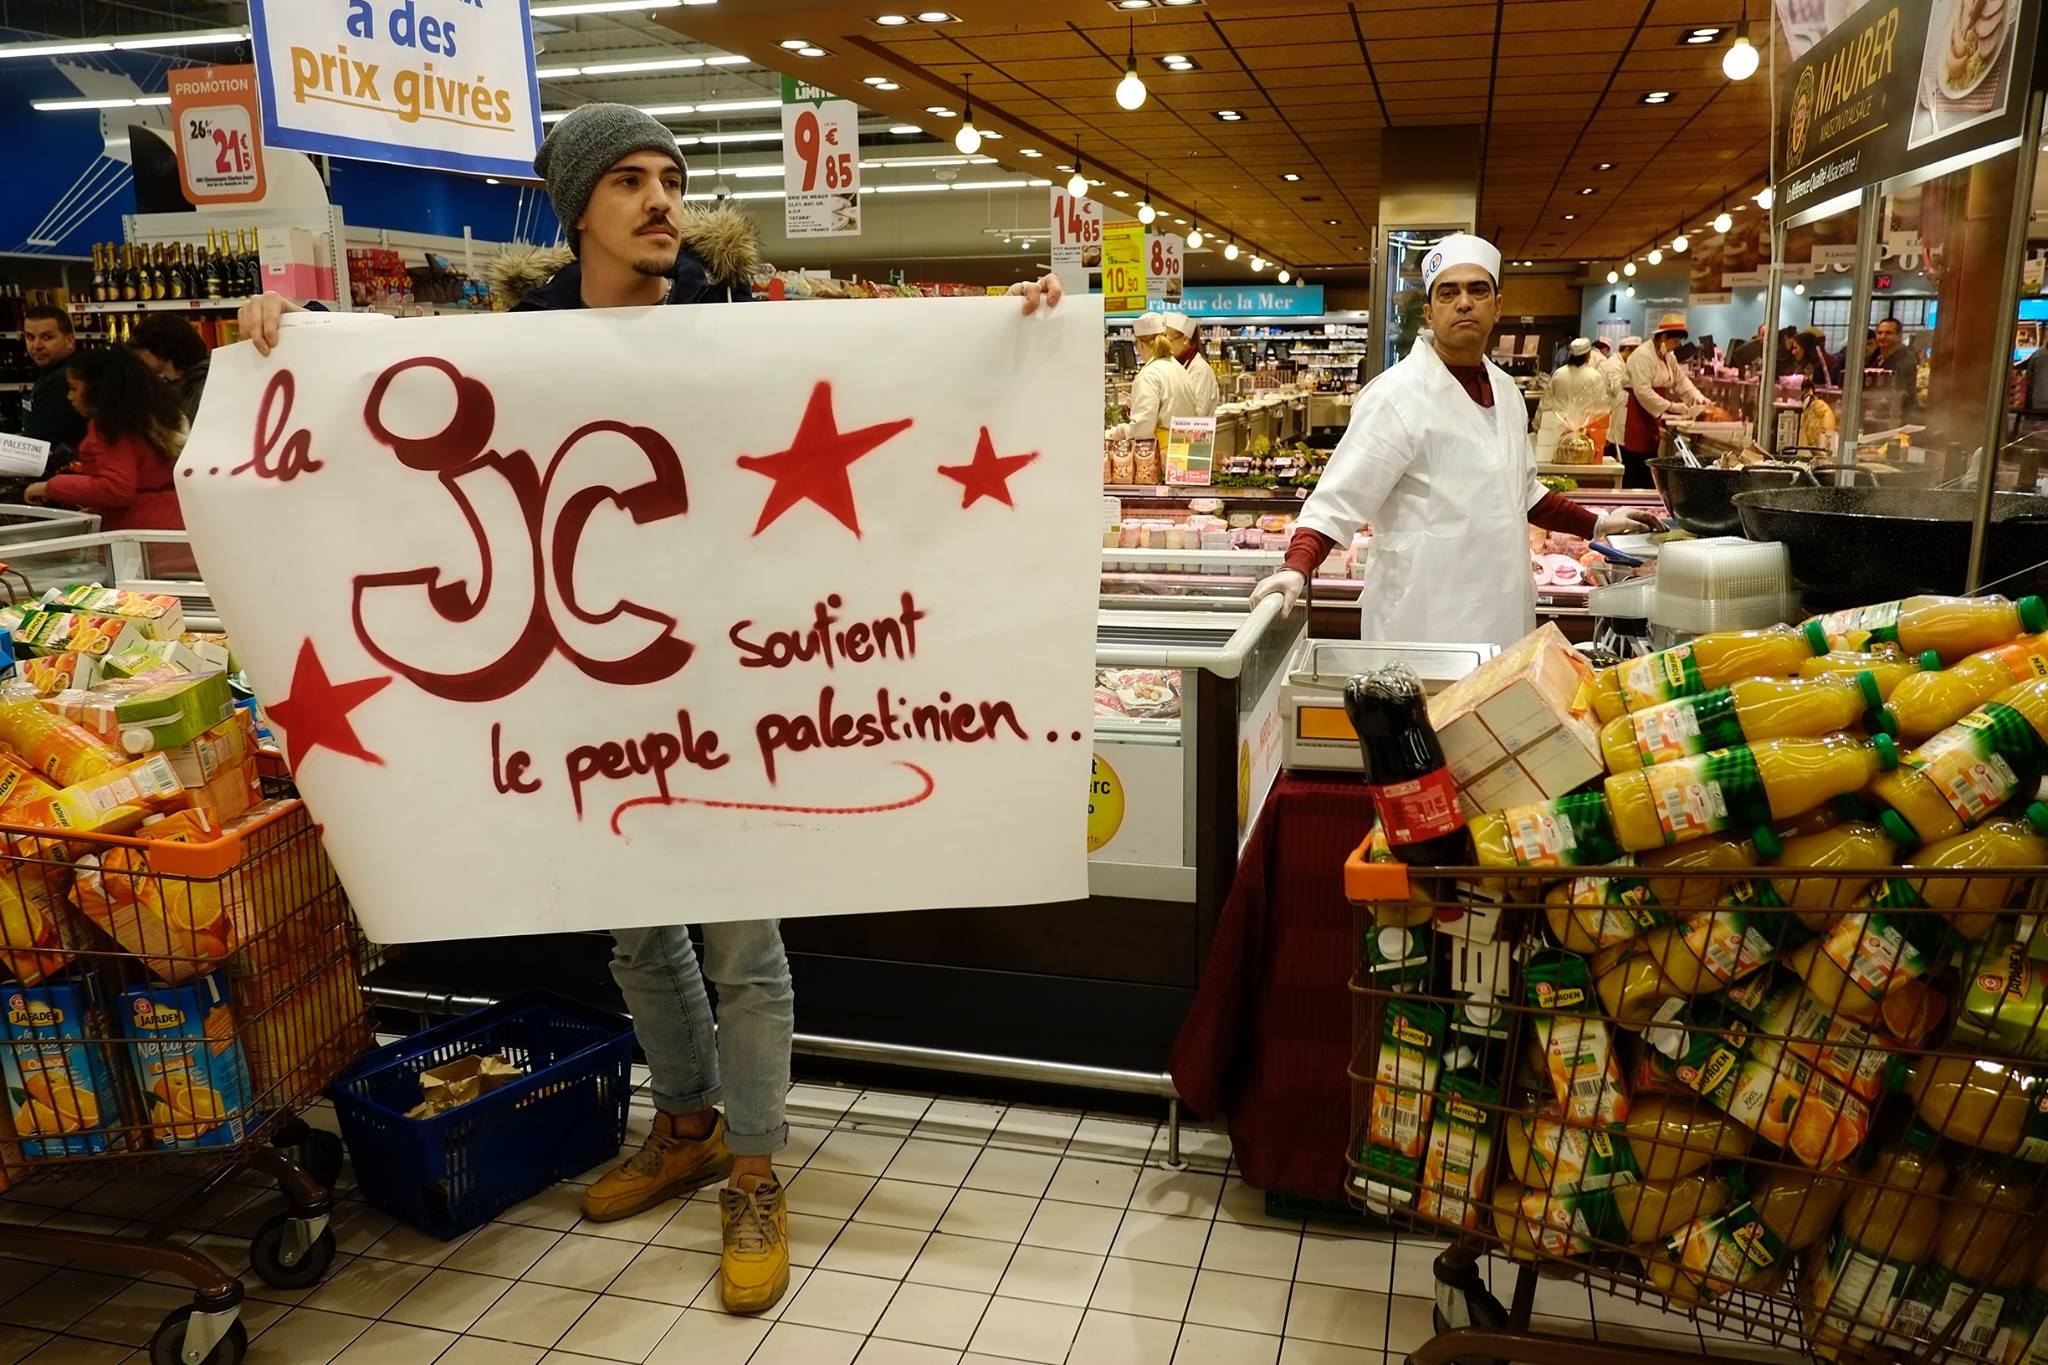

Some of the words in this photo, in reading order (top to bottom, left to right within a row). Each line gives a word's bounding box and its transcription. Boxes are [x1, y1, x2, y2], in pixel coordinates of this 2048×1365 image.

[389, 0, 456, 58] des
[1814, 7, 1899, 120] MAURER
[175, 78, 249, 95] PROMOTION
[291, 45, 381, 103] prix
[394, 62, 512, 123] givrés
[795, 85, 838, 100] LIMIT
[794, 111, 820, 191] 9
[826, 154, 852, 189] 85
[1149, 297, 1207, 311] raiteur
[1212, 294, 1232, 310] de
[1238, 293, 1252, 310] la
[1258, 293, 1293, 310] Mer
[730, 591, 925, 670] soutient
[491, 723, 542, 795] le
[566, 710, 731, 822] peuple
